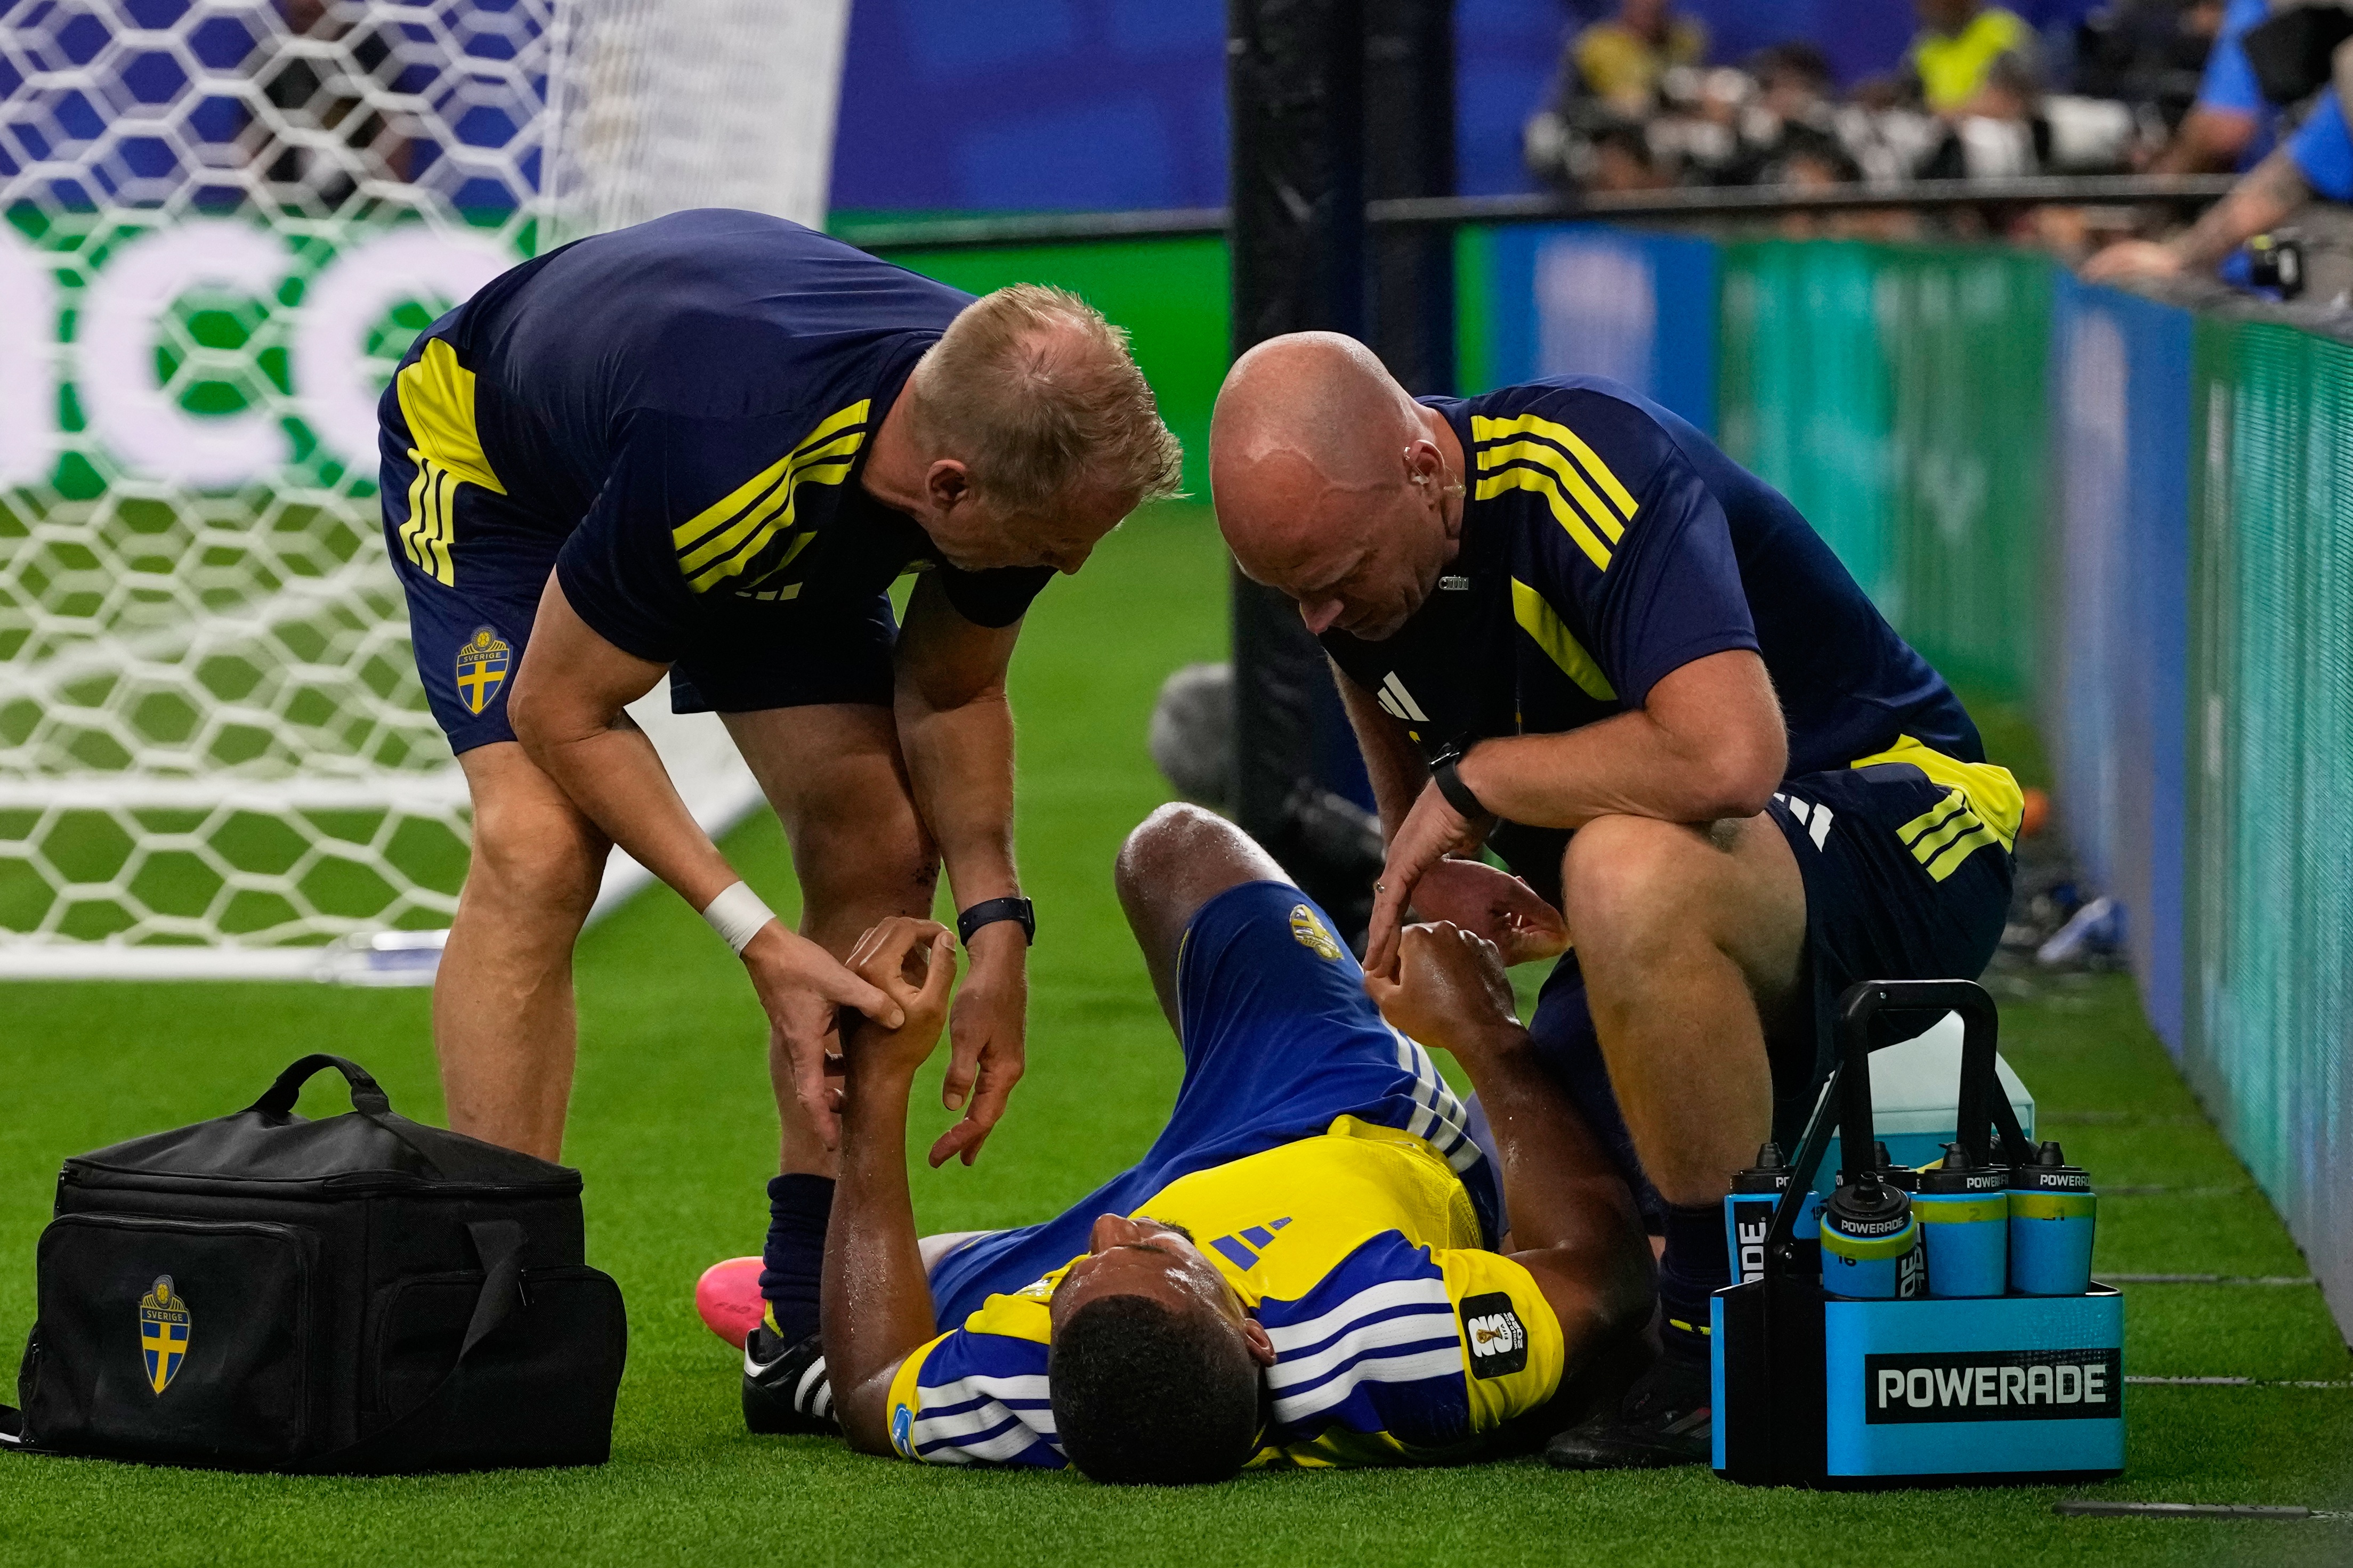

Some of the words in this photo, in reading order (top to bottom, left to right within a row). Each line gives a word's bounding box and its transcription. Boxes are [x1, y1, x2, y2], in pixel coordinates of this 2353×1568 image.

[464, 652, 502, 662] SVERIGE
[1841, 1216, 1905, 1234] POWERADE
[147, 1310, 183, 1322] SVERIGE
[1503, 1312, 1512, 1326] CUP
[1500, 1323, 1509, 1340] FIFA
[1507, 1312, 1523, 1349] 2026
[1509, 1325, 1518, 1350] WORLD
[1878, 1364, 2107, 1408] POWERADE
